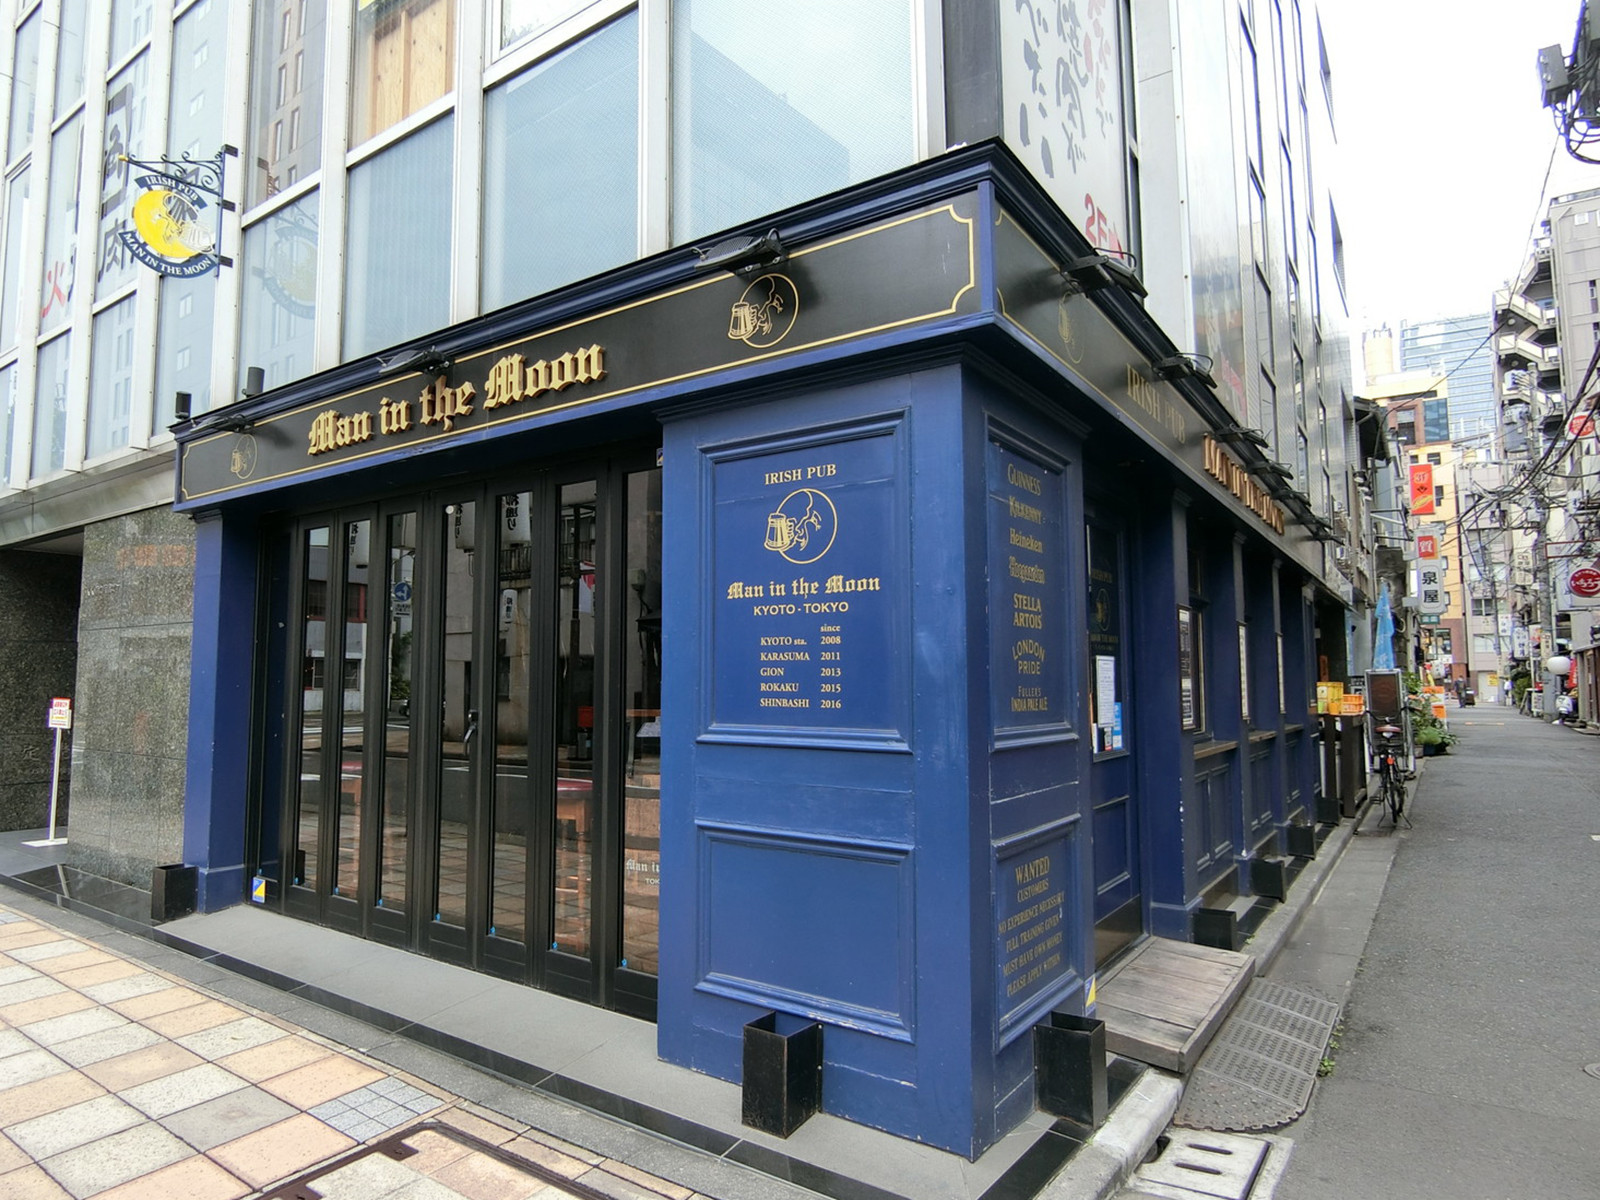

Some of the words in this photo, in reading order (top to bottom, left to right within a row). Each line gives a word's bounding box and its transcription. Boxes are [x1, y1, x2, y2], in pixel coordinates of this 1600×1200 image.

[145, 176, 176, 188] IRISH
[178, 184, 199, 201] PUB
[124, 232, 144, 255] MAN
[144, 254, 158, 267] IN
[159, 263, 182, 276] THE
[183, 257, 212, 276] MOON
[307, 409, 374, 456] Man
[379, 397, 413, 435] in
[419, 375, 477, 432] the
[482, 343, 607, 411] Moon
[1126, 362, 1161, 423] IRISH
[1164, 402, 1186, 445] PUB
[764, 468, 802, 485] IRISH
[806, 463, 837, 479] PUB
[727, 580, 764, 600] Man
[769, 580, 786, 597] in
[791, 577, 818, 599] the
[825, 574, 881, 594] Moon
[1422, 571, 1439, 604] 泉屋
[753, 604, 796, 616] KYOTO
[803, 601, 849, 614] TOKYO
[1013, 593, 1042, 612] STELLA
[820, 624, 841, 632] since
[1013, 611, 1042, 629] ARTOIS
[760, 637, 792, 646] KYOTO
[793, 638, 807, 646] sta.
[820, 635, 841, 645] 2008
[760, 652, 810, 661] KARASUMA
[820, 652, 841, 661] 2011
[1011, 639, 1045, 662] LONDON
[760, 668, 785, 677] GION
[820, 667, 841, 677] 2013
[1018, 660, 1041, 675] PRIDE
[760, 683, 799, 692] ROKAKU
[820, 683, 841, 693] 2015
[760, 698, 810, 708] SHINBASHI
[820, 699, 841, 709] 2016
[1015, 856, 1050, 885] WANTED
[1006, 938, 1019, 953] FULL
[1020, 922, 1044, 945] TRAINING
[1019, 949, 1034, 968] HAVE
